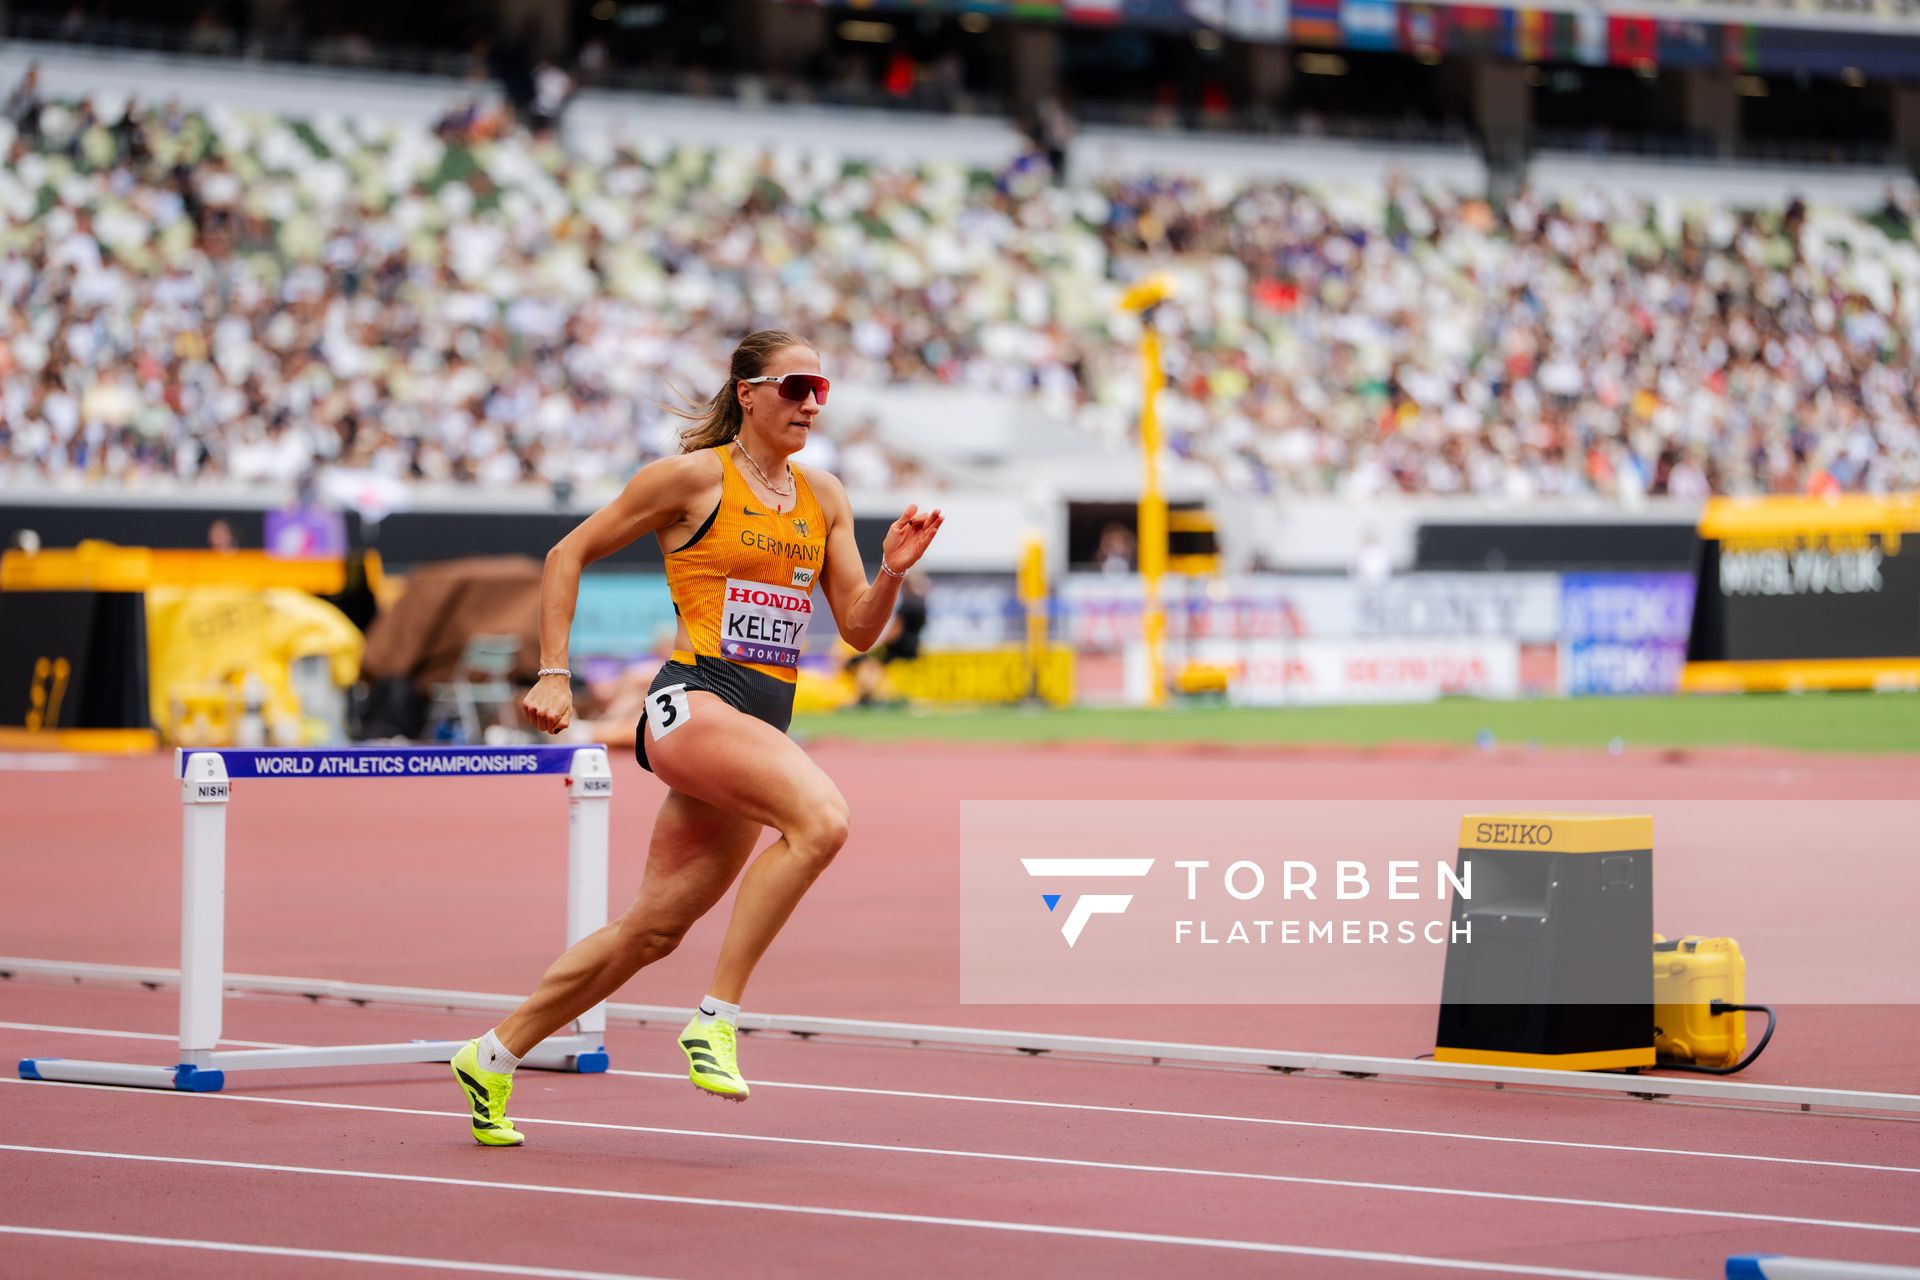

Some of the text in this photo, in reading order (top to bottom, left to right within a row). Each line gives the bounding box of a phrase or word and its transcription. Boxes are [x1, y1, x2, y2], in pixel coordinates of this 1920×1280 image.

[741, 530, 820, 561] GERMANY
[794, 571, 814, 582] WGV
[728, 587, 811, 613] HONDA
[728, 613, 803, 645] KELETY
[655, 694, 677, 728] 3
[255, 754, 538, 774] WORLD ATHLETICS CHAMPIONSHIPS
[199, 786, 228, 797] NISHI
[1476, 822, 1553, 845] SEIKO
